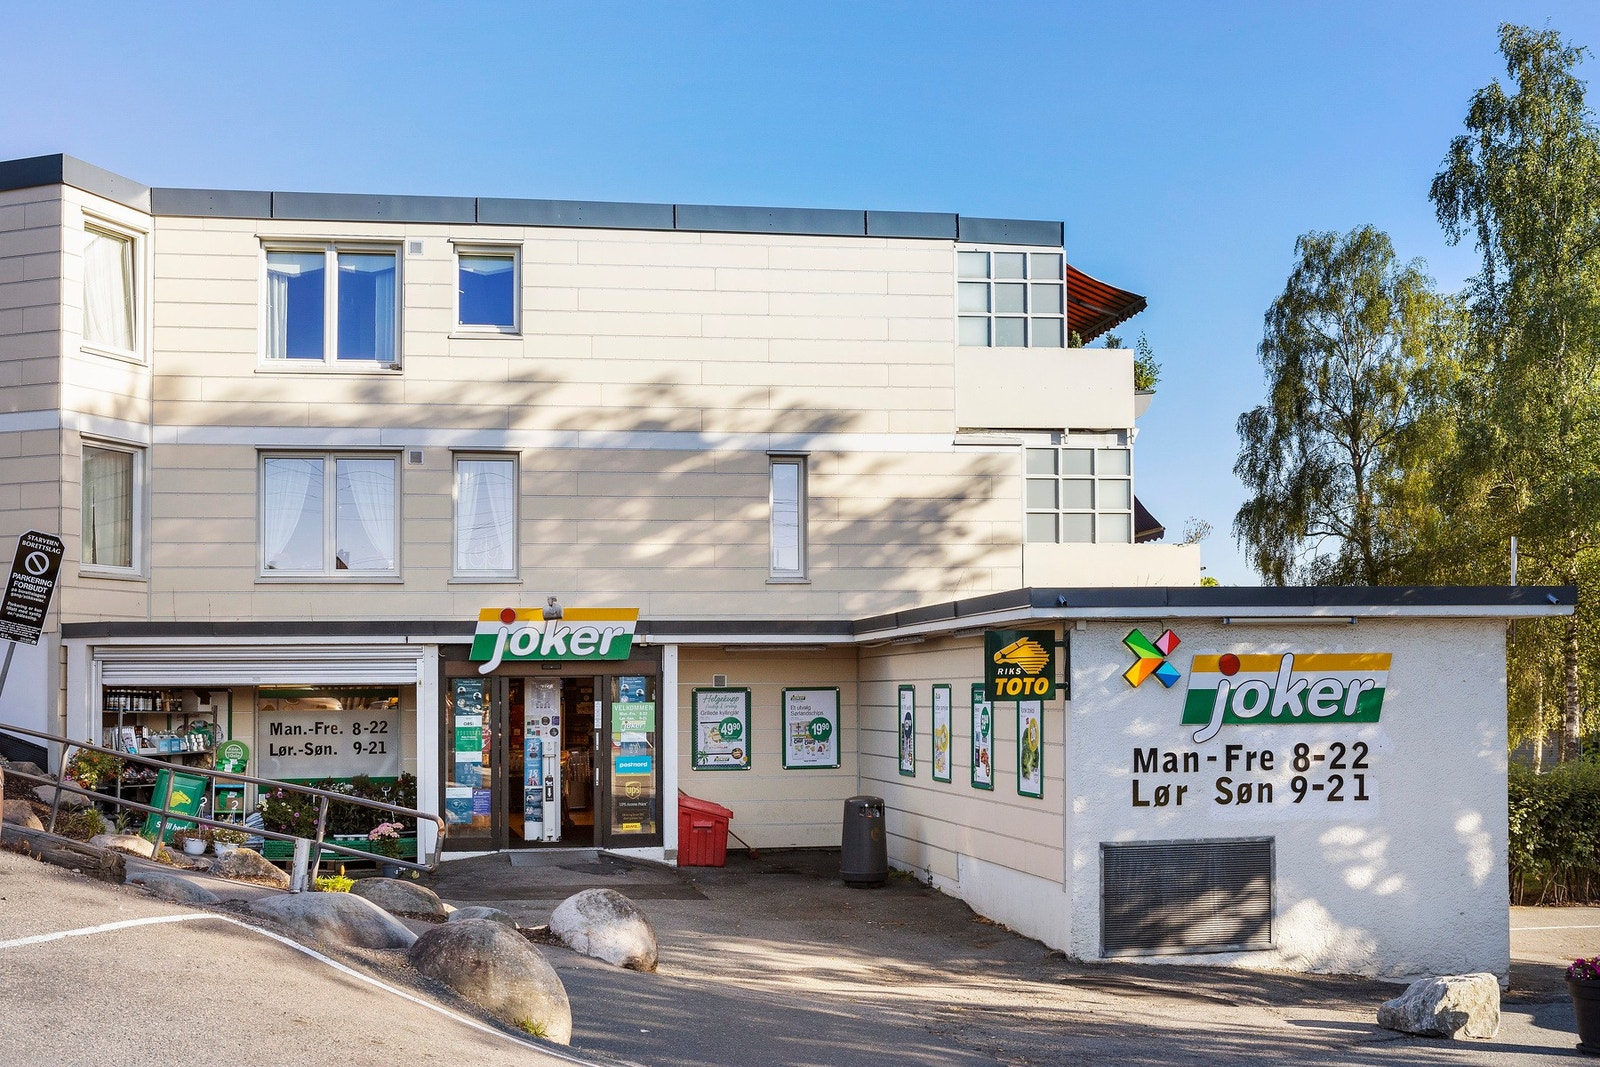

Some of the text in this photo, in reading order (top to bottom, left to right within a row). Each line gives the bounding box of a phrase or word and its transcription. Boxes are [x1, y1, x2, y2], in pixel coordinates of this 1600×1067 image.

[21, 540, 61, 555] BORETTSLAG
[12, 572, 53, 588] PARKERING
[13, 580, 48, 594] FORBUDT
[478, 607, 626, 675] joker
[995, 677, 1050, 696] TOTO
[1193, 652, 1376, 744] joker
[269, 720, 389, 736] Man.-Fre. 8-22
[269, 741, 388, 757] Lør.-Søn. 9-21
[1291, 742, 1370, 773] 8-22
[1132, 774, 1370, 808] Lør Søn 9-21
[156, 821, 173, 830] Sill
